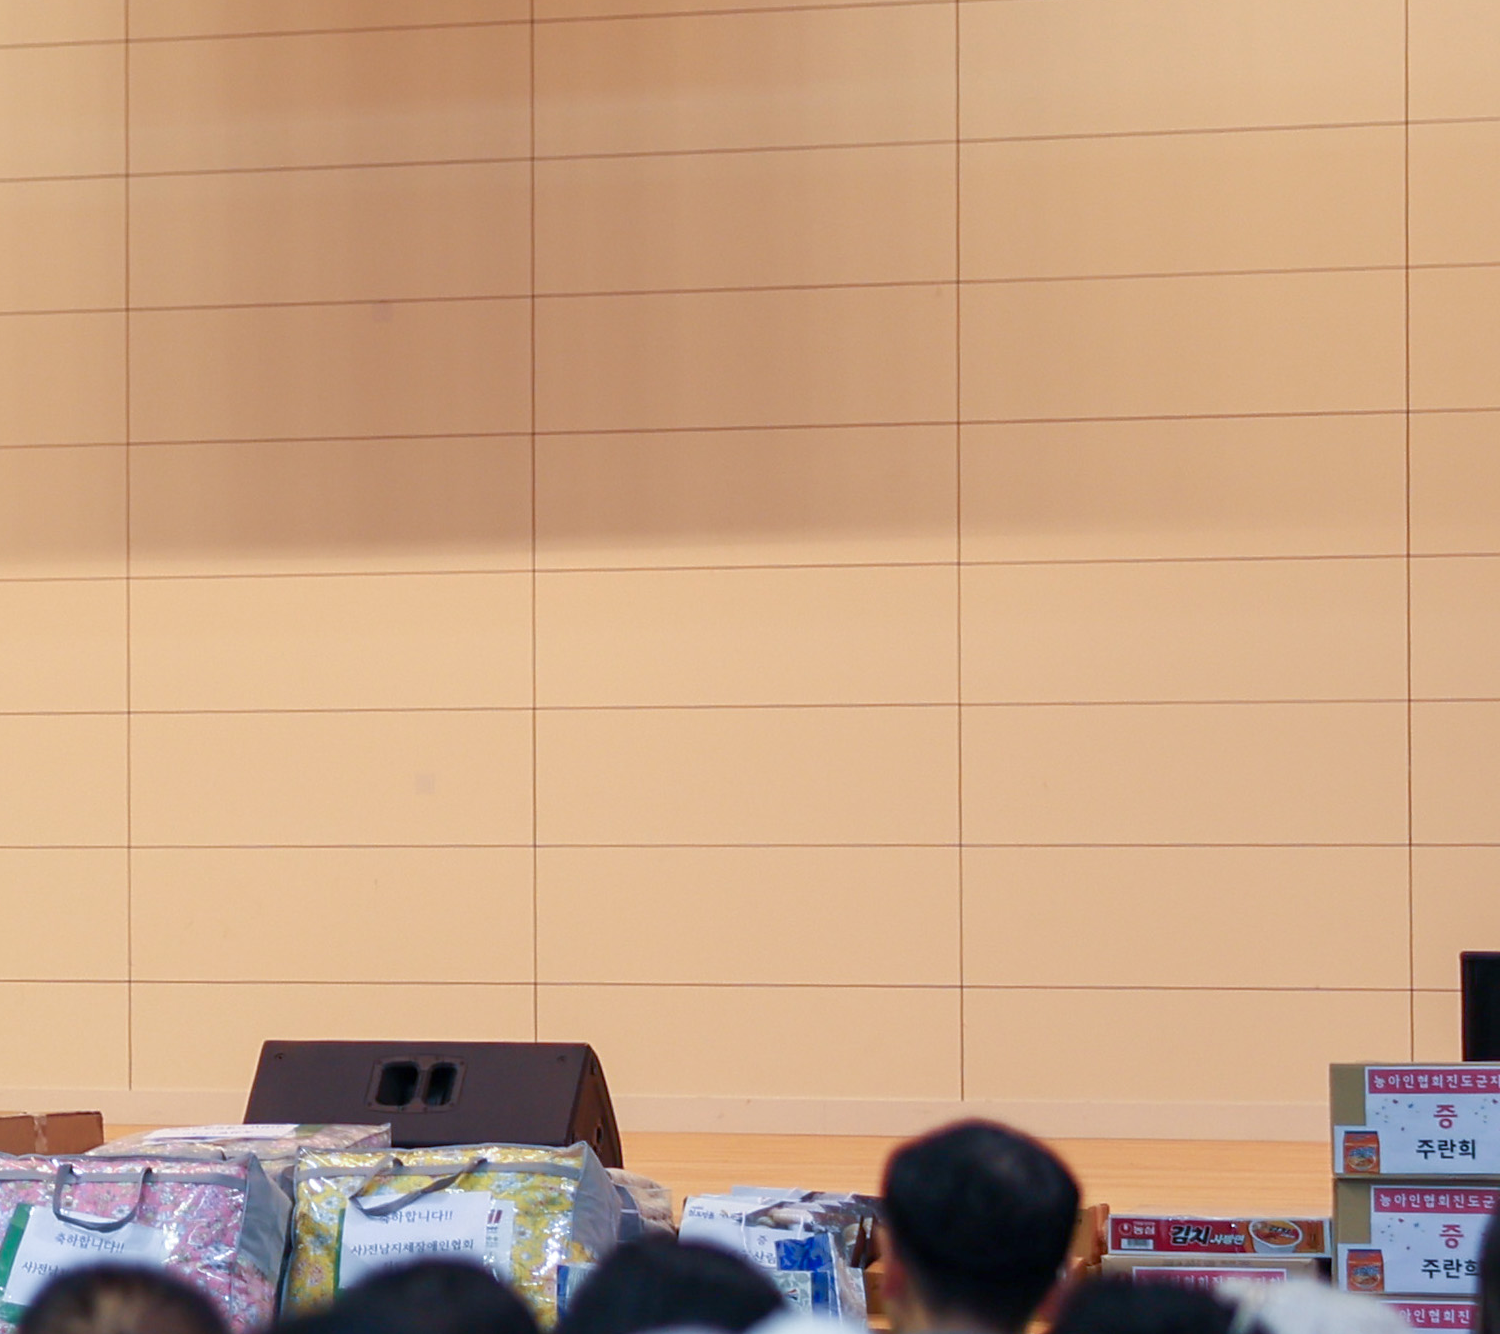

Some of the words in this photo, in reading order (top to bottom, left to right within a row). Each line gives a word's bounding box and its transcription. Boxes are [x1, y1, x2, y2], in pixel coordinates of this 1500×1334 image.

[1433, 1103, 1459, 1130] 증
[1415, 1138, 1477, 1160] 주란희
[1379, 1193, 1495, 1209] 농아인협회진도군
[54, 1232, 125, 1254] 축하합니다!!
[1169, 1224, 1212, 1247] 김치
[1439, 1223, 1465, 1250] 증
